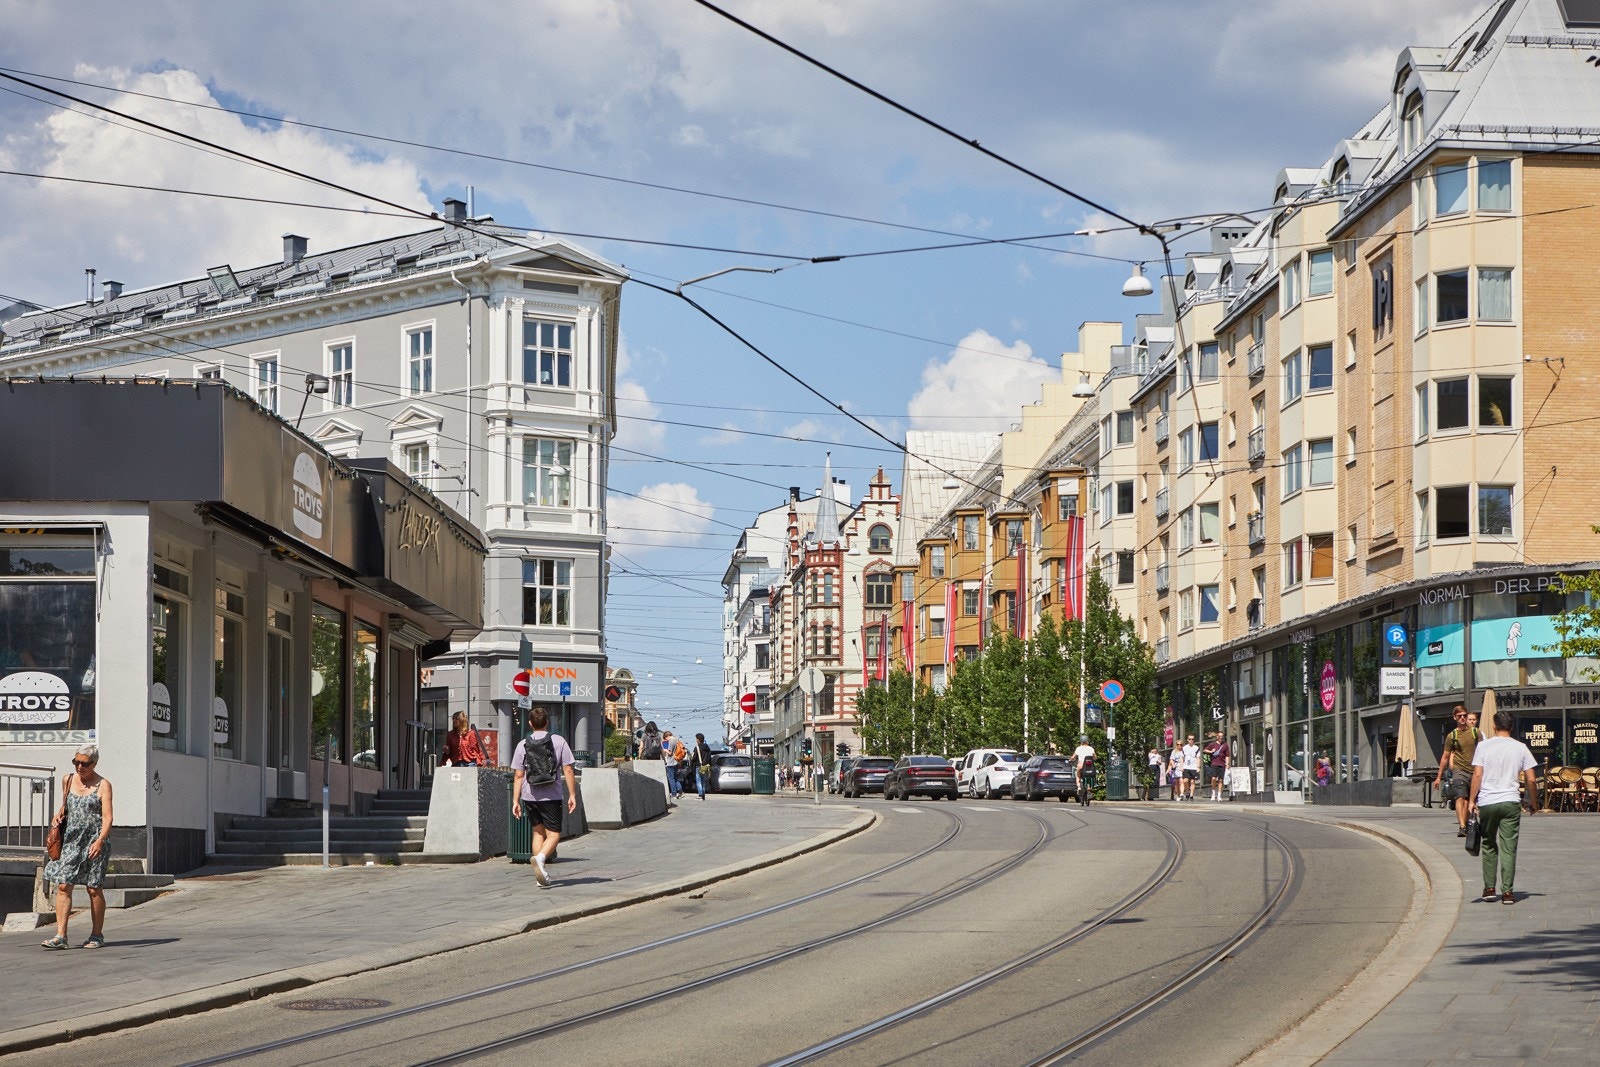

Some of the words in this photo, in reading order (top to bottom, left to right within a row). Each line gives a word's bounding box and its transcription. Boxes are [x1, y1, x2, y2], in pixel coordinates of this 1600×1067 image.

[292, 484, 322, 520] TROYS
[1495, 578, 1530, 595] DER
[1419, 584, 1469, 606] NORMAL
[1570, 691, 1589, 704] DER
[1592, 690, 1600, 704] P
[1212, 707, 1223, 719] K
[1533, 724, 1546, 732] DER
[1573, 722, 1599, 730] AMAZING
[1525, 731, 1555, 740] PEPPERN
[1575, 729, 1596, 737] BUTTER
[1573, 736, 1598, 744] CHICKEN
